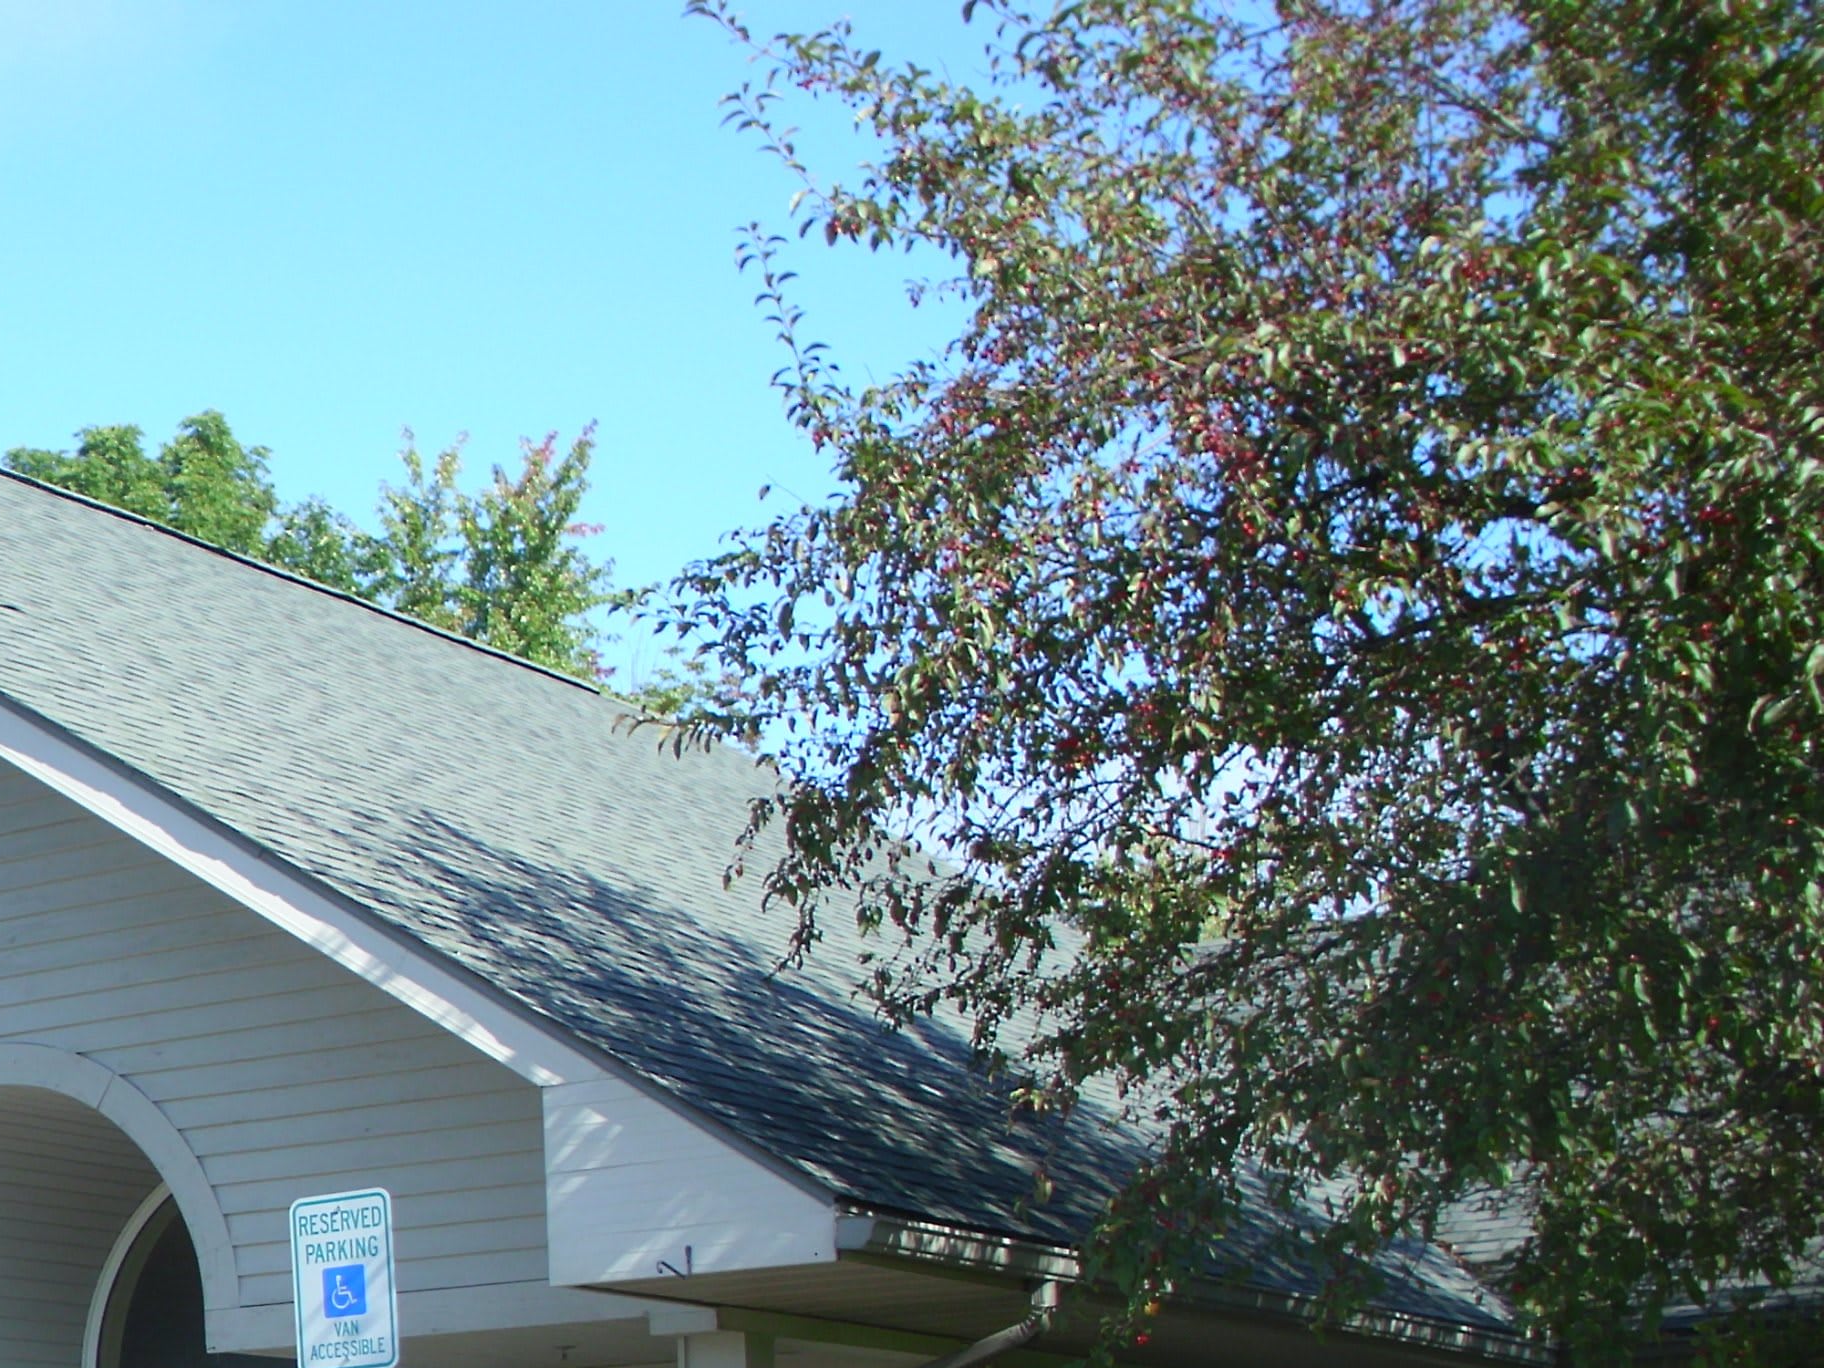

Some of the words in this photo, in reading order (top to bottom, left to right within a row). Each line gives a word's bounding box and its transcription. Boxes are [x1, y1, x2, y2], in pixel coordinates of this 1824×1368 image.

[298, 1206, 382, 1237] RESERVED
[305, 1236, 379, 1264] PARKING
[334, 1320, 359, 1336] VAN
[310, 1337, 386, 1360] ACCESSIBLE
